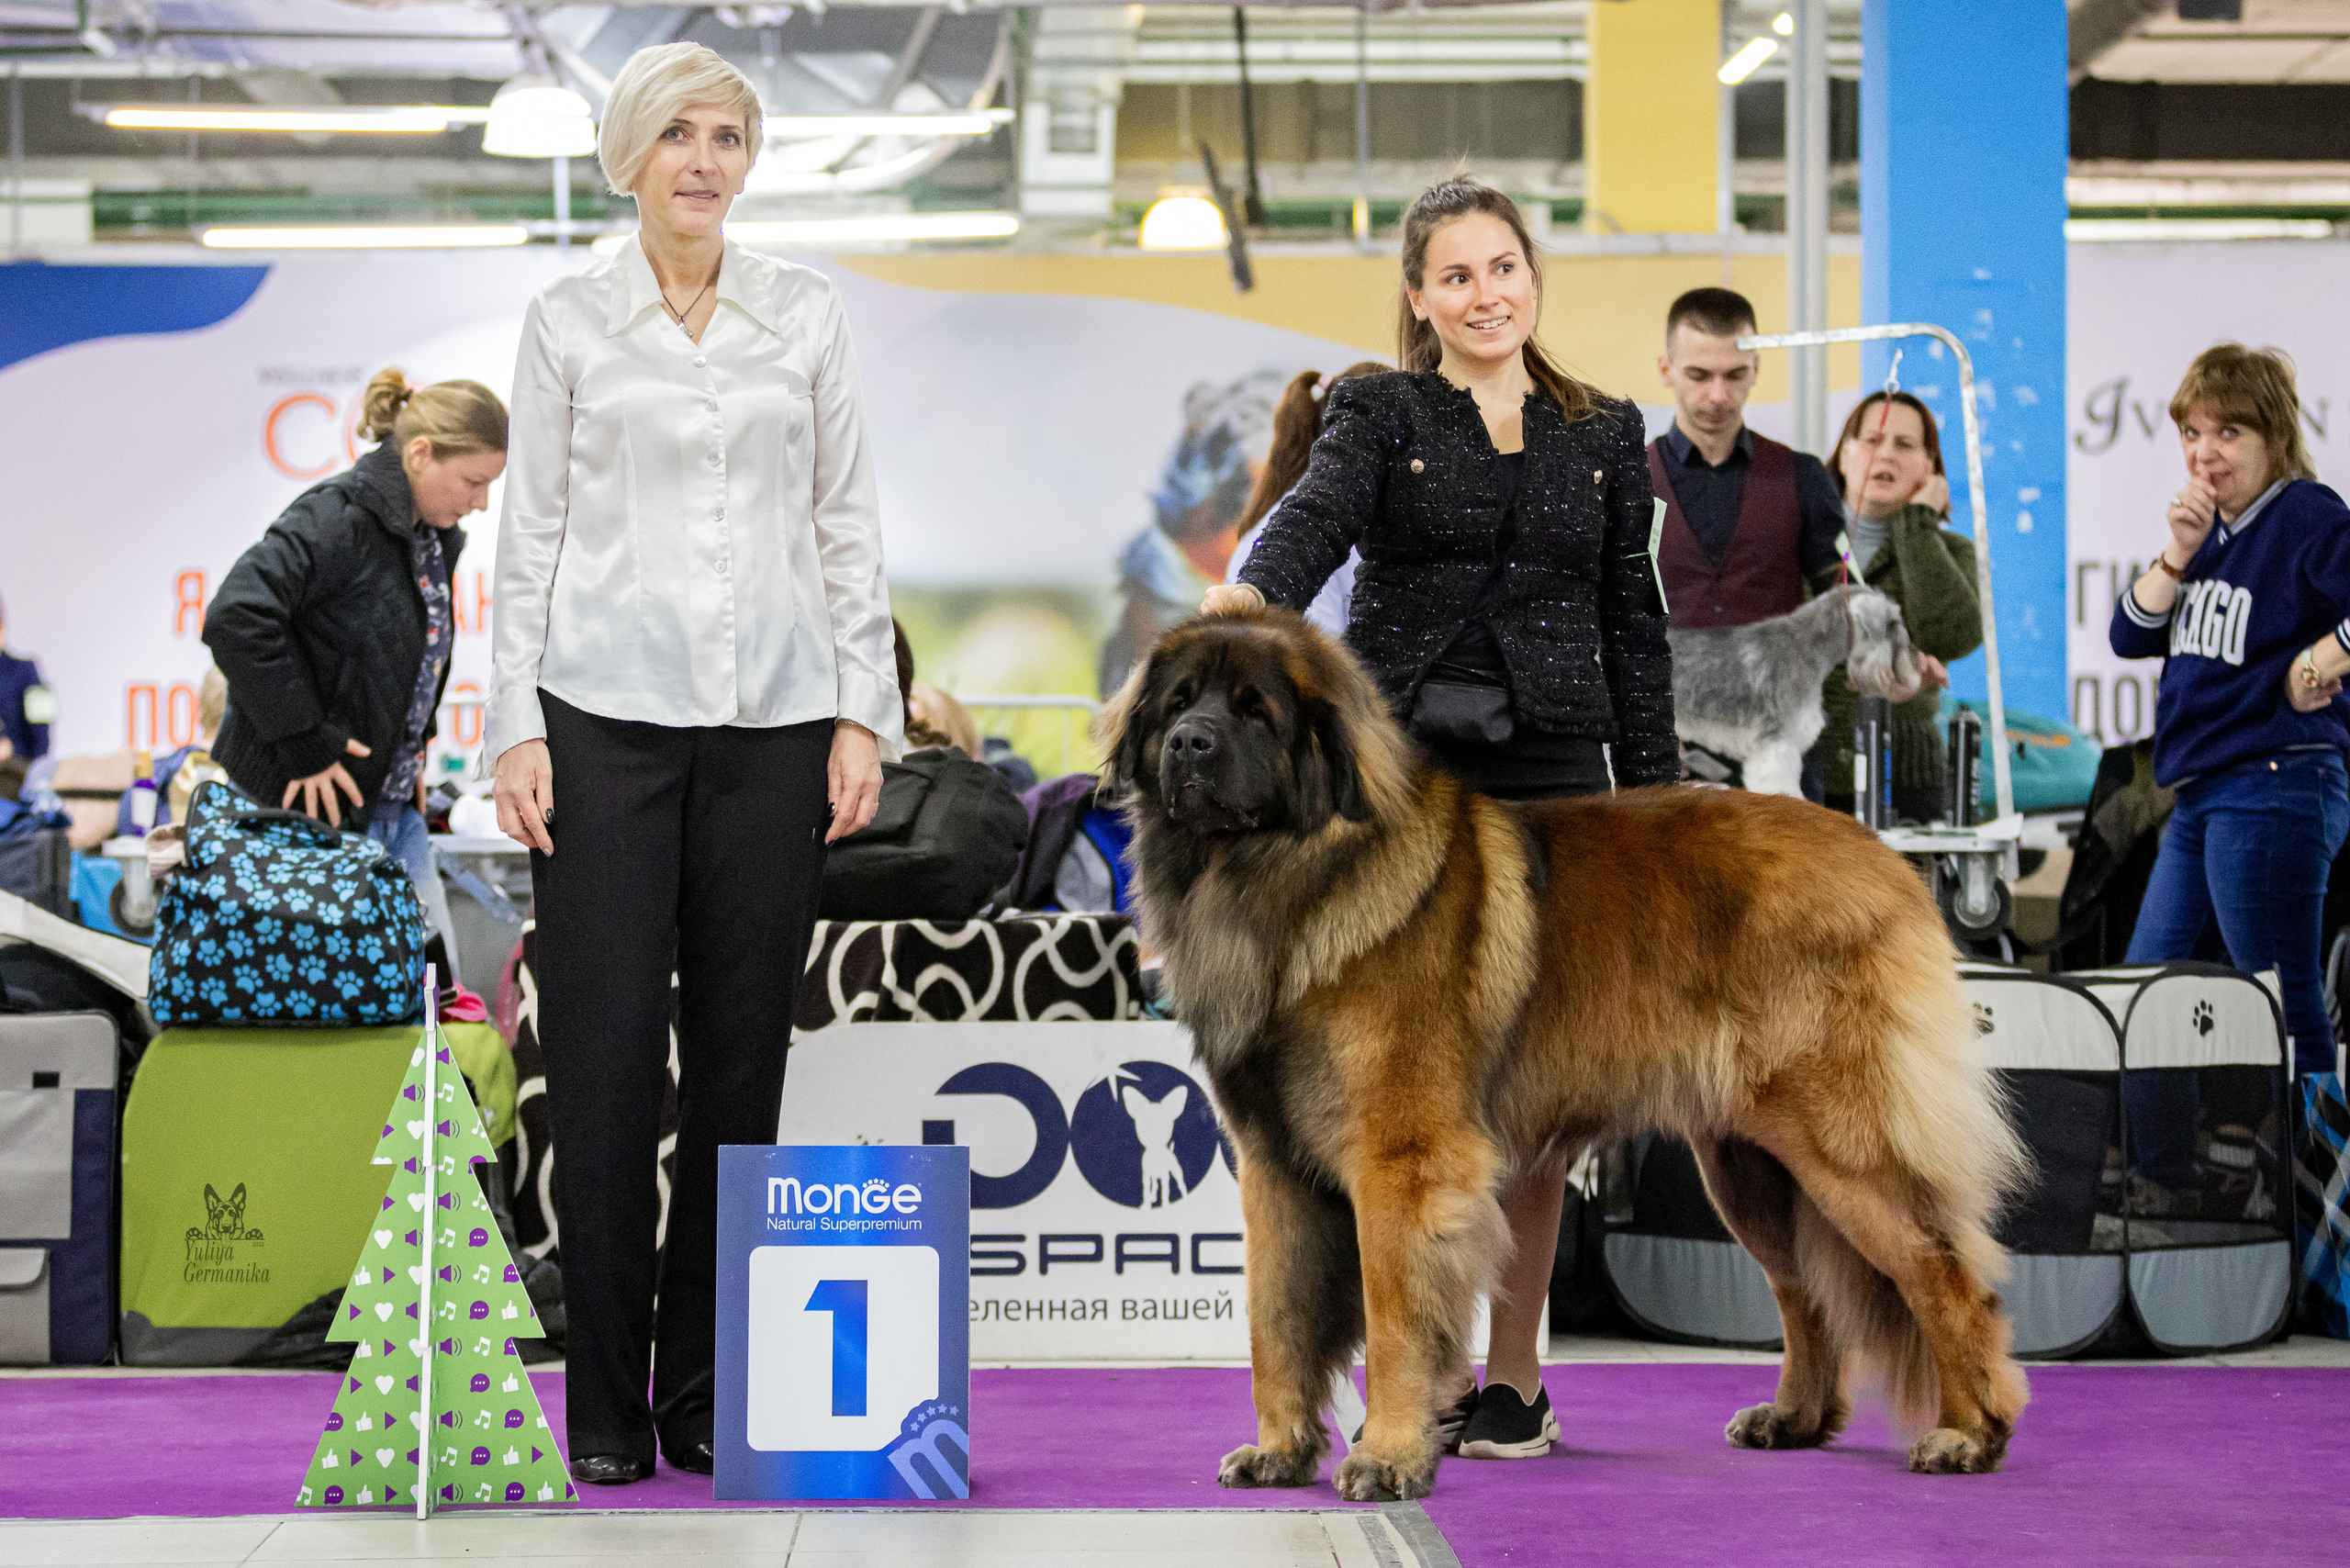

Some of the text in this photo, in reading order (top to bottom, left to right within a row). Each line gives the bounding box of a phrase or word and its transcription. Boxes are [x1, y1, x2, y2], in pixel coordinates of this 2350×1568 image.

[129, 685, 198, 750] ПО
[2074, 676, 2158, 745] ДО
[767, 1216, 923, 1233] Natural Superpremium
[185, 1239, 235, 1266] Yuliya
[970, 1233, 1244, 1276] SPAC
[184, 1261, 271, 1282] Germanika
[969, 1290, 1233, 1321] еленная вашей
[803, 1280, 867, 1417] 1
